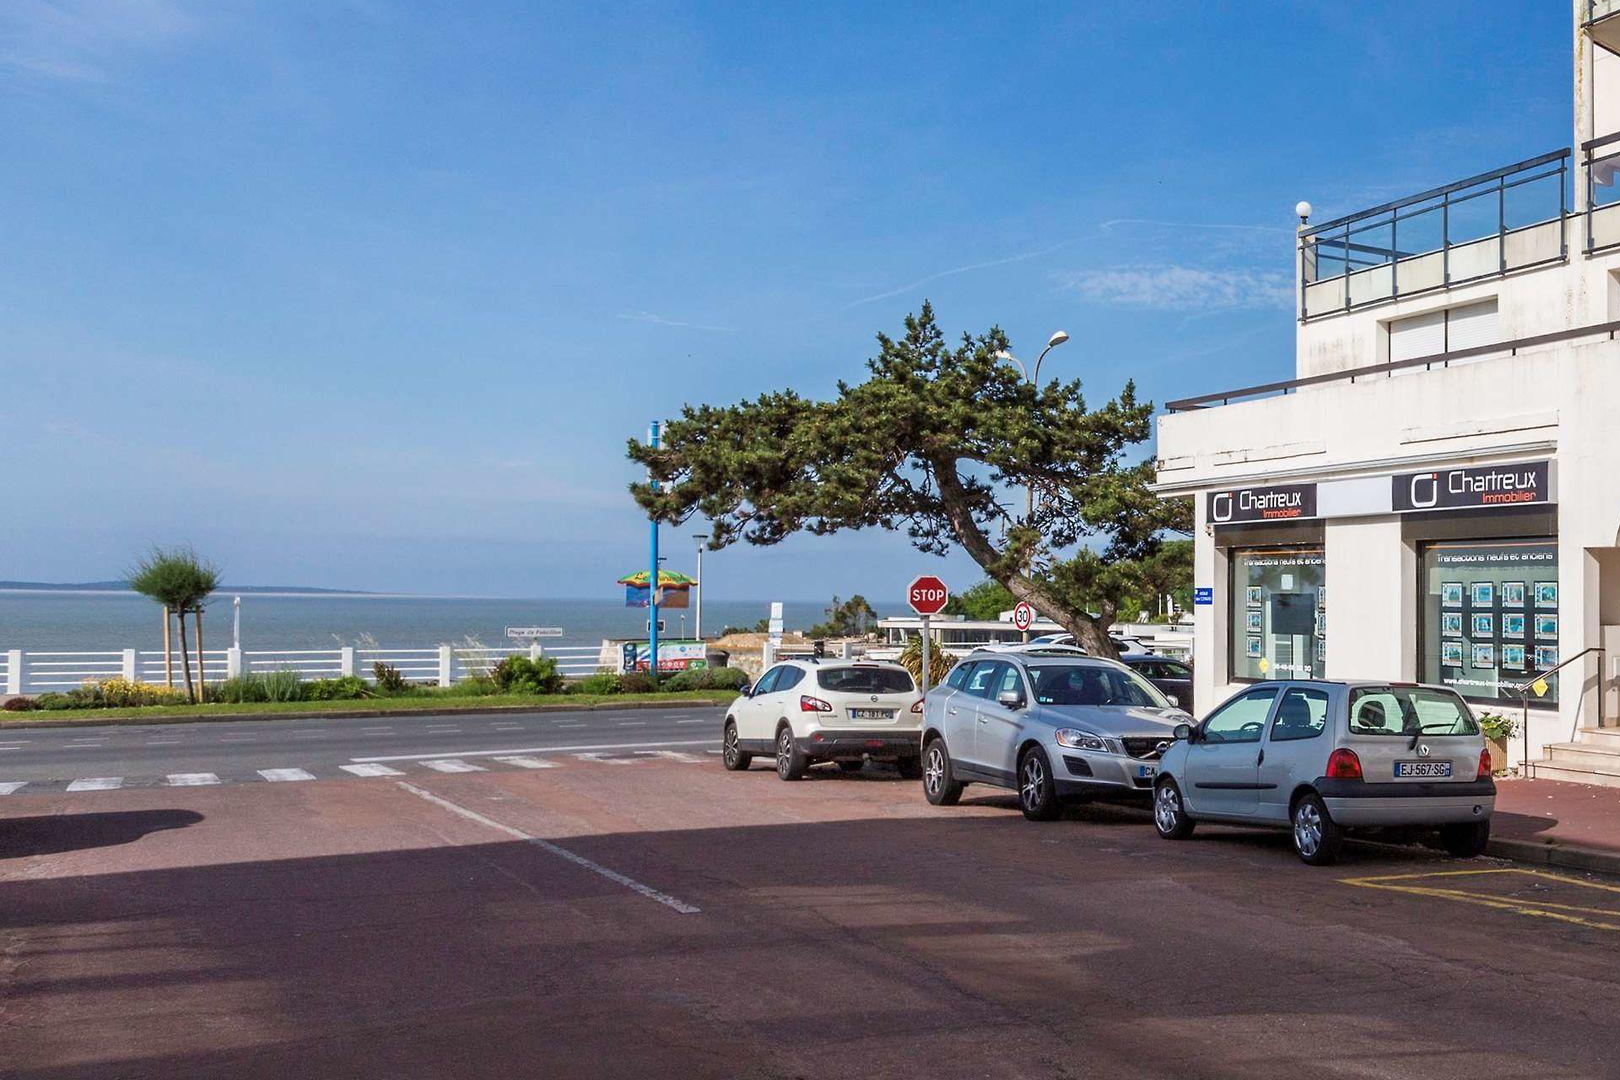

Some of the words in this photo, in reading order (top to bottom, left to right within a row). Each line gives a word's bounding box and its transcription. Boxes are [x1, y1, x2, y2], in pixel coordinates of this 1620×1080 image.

[1448, 470, 1537, 494] Chartreux
[1240, 490, 1302, 510] Chartreux
[1482, 491, 1537, 504] Immobilier
[1262, 508, 1302, 519] Immobilier
[912, 589, 945, 602] STOP
[1017, 610, 1028, 623] 30
